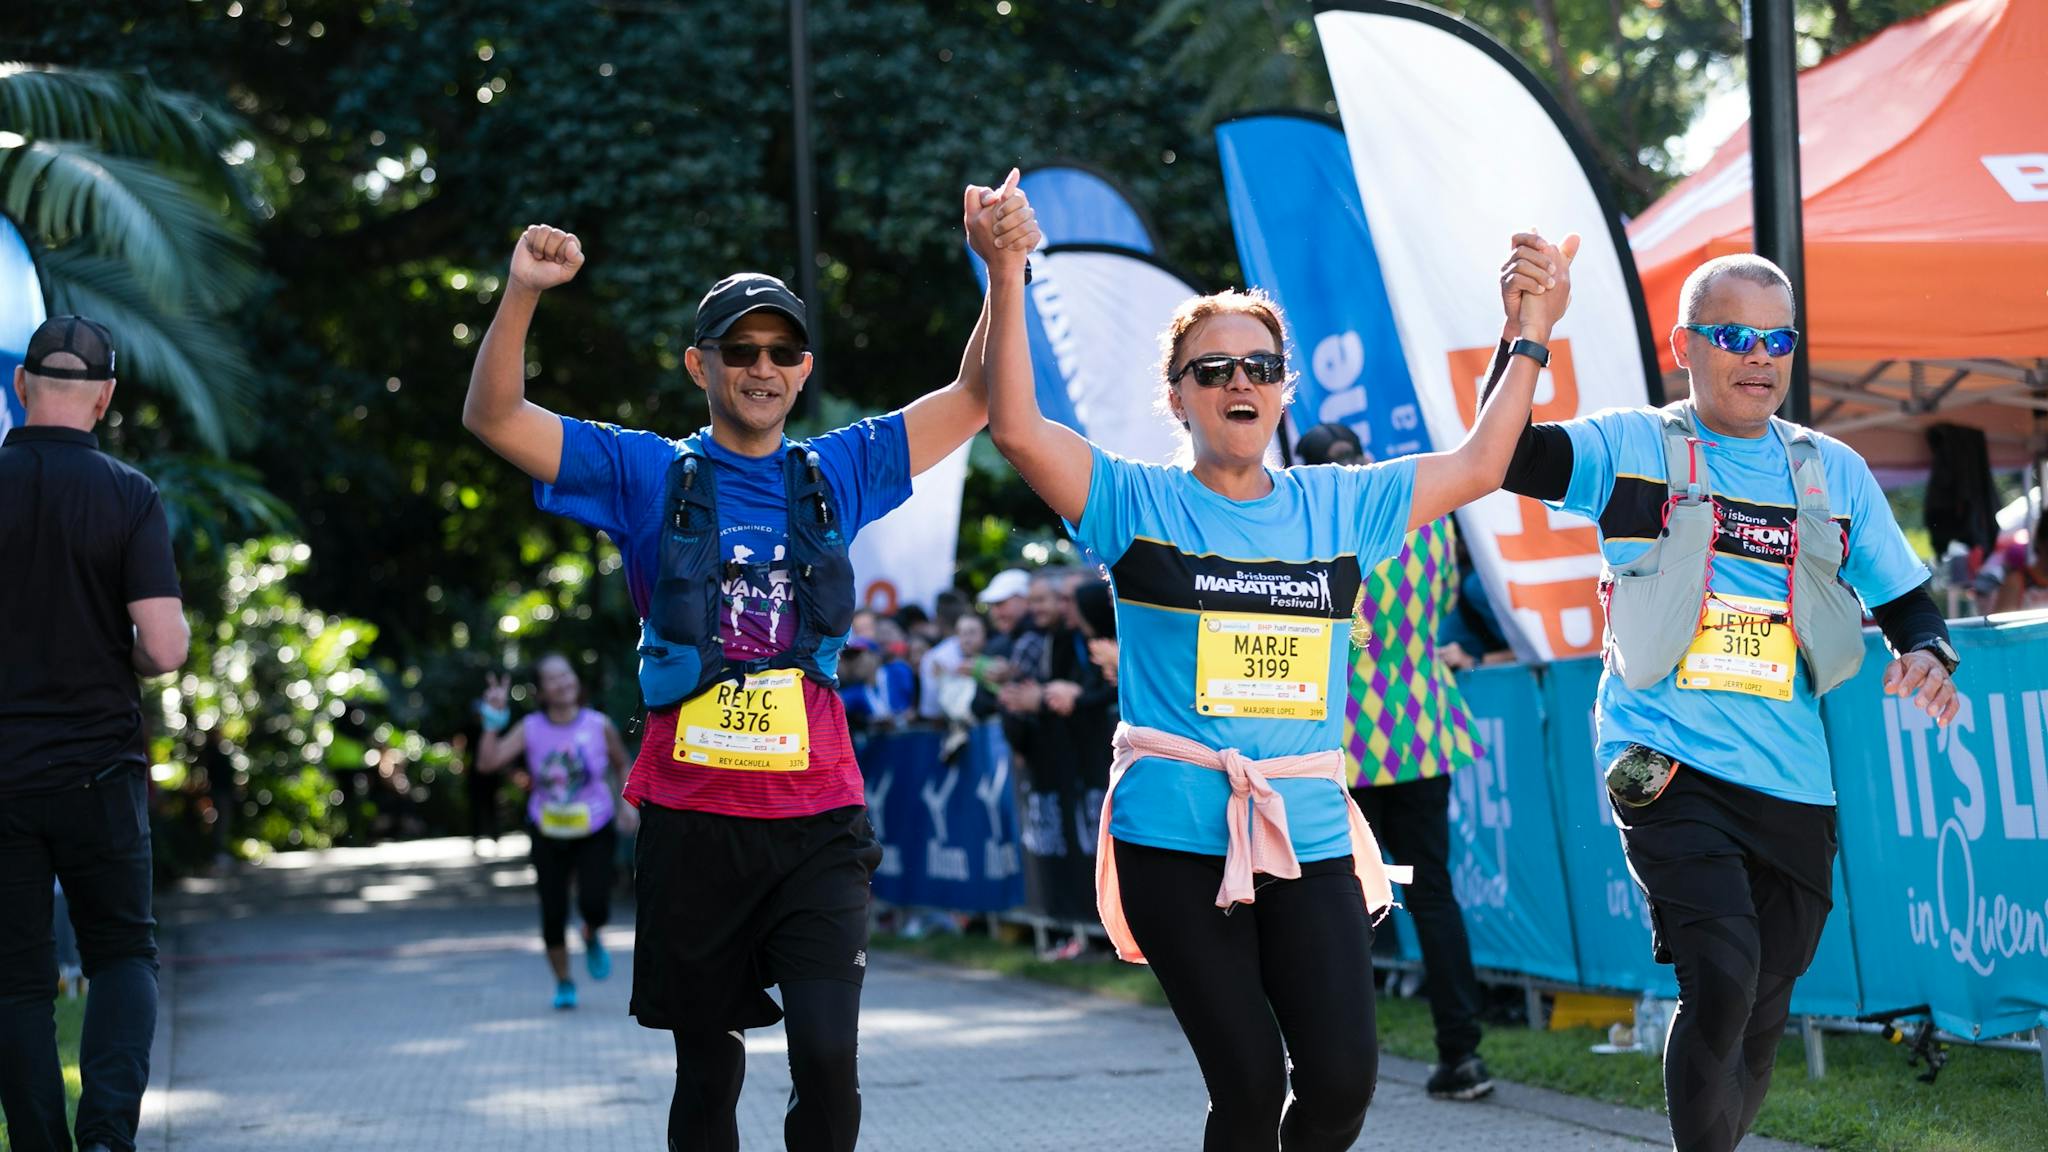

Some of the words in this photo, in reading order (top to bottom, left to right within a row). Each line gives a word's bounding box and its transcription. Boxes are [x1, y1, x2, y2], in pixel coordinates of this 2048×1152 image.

[1743, 541, 1787, 556] Festival
[1236, 571, 1291, 581] Brisbane
[1195, 574, 1319, 597] MARATHON
[1270, 596, 1318, 609] Festival
[1287, 625, 1320, 634] marathon
[1714, 612, 1771, 638] JEYLO
[1234, 635, 1299, 657] MARJE
[1723, 634, 1761, 657] 3113
[1243, 657, 1290, 679] 3199
[1723, 680, 1743, 689] JERRY
[1744, 682, 1762, 692] LOPEZ
[717, 685, 757, 710] REY
[762, 690, 778, 710] C.
[1243, 706, 1275, 715] MARJORIE
[1276, 707, 1296, 716] LOPEZ
[1310, 709, 1324, 717] 3199
[719, 709, 771, 733] 3376
[719, 757, 733, 766] REY
[734, 758, 771, 768] CACHUELA
[789, 760, 805, 768] 3376
[1988, 689, 2048, 840] LI
[1907, 886, 1939, 949] in
[1937, 817, 2048, 977] Queen
